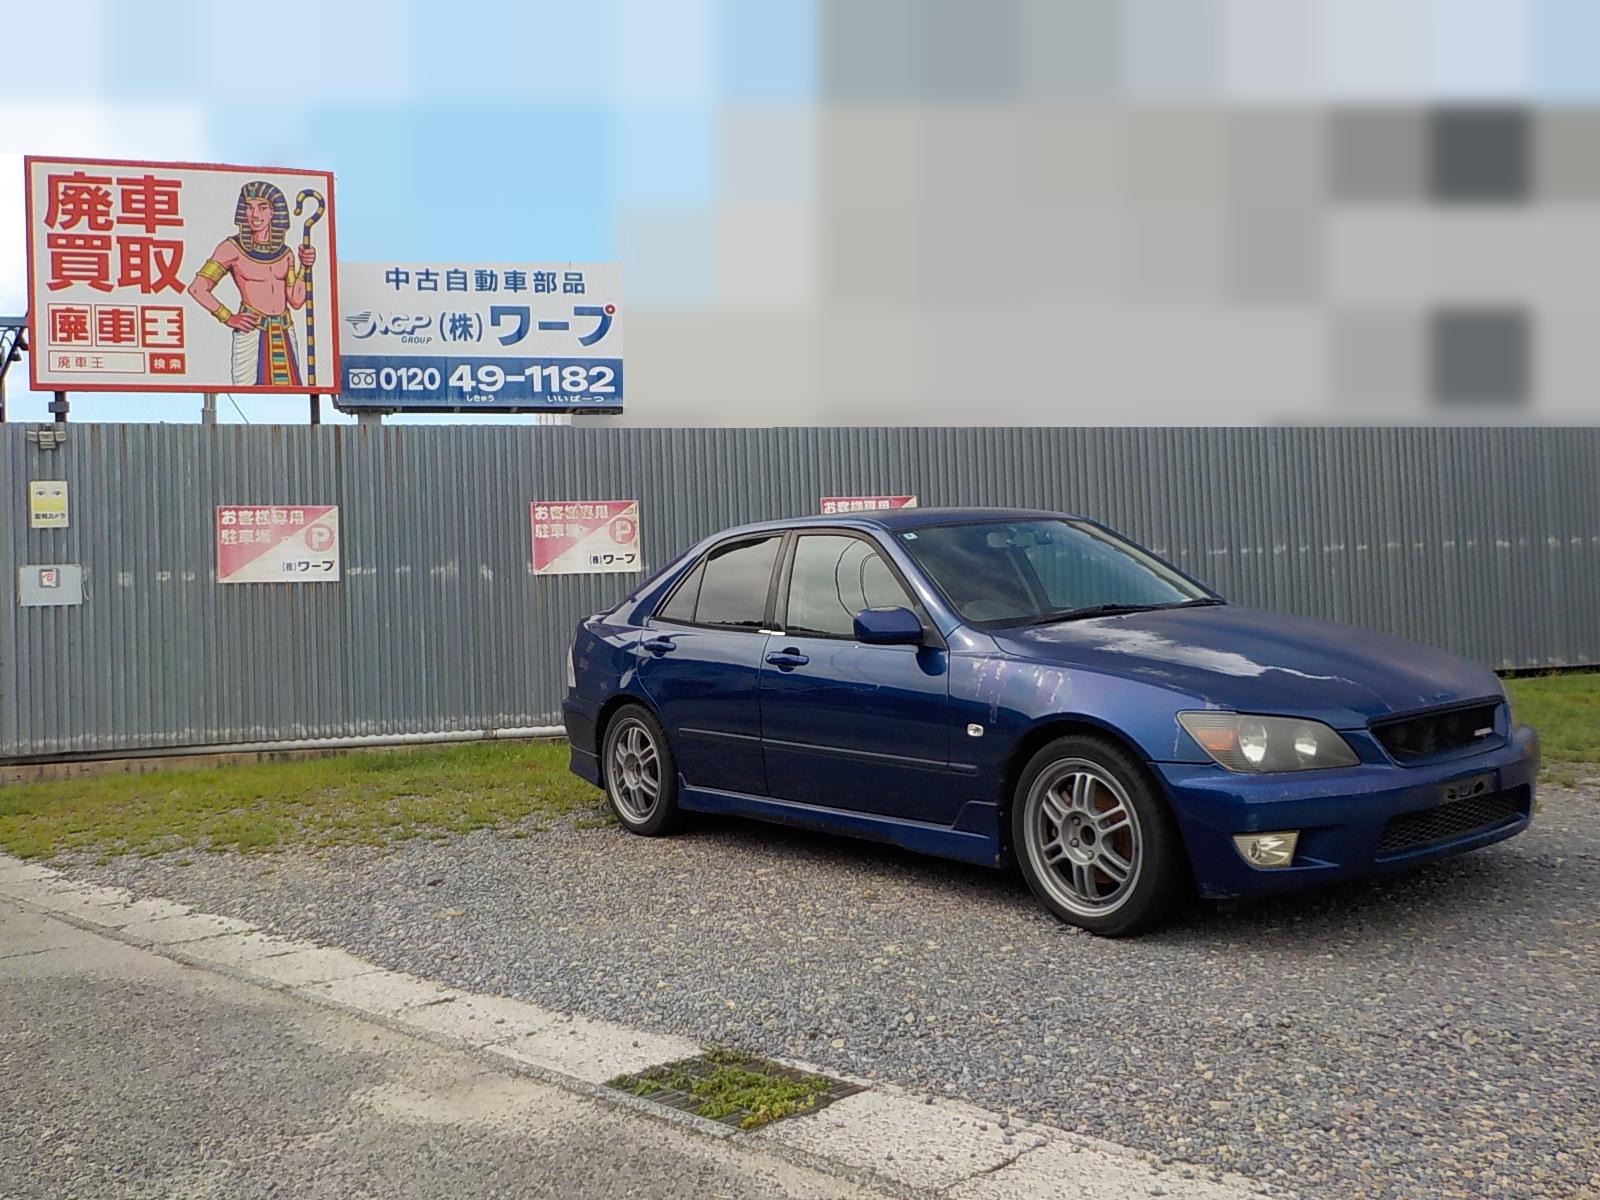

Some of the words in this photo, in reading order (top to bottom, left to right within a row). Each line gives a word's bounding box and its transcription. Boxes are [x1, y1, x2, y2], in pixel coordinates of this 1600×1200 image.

[44, 171, 184, 233] 廃車
[46, 233, 186, 294] 買取
[385, 267, 586, 294] 中古自動車部品
[48, 303, 184, 348] 廃車王
[401, 336, 432, 344] GROUP
[58, 356, 104, 368] 廃車王
[379, 367, 441, 391] 0120
[448, 364, 616, 393] 49-1182
[311, 527, 330, 549] P
[615, 521, 632, 542] P
